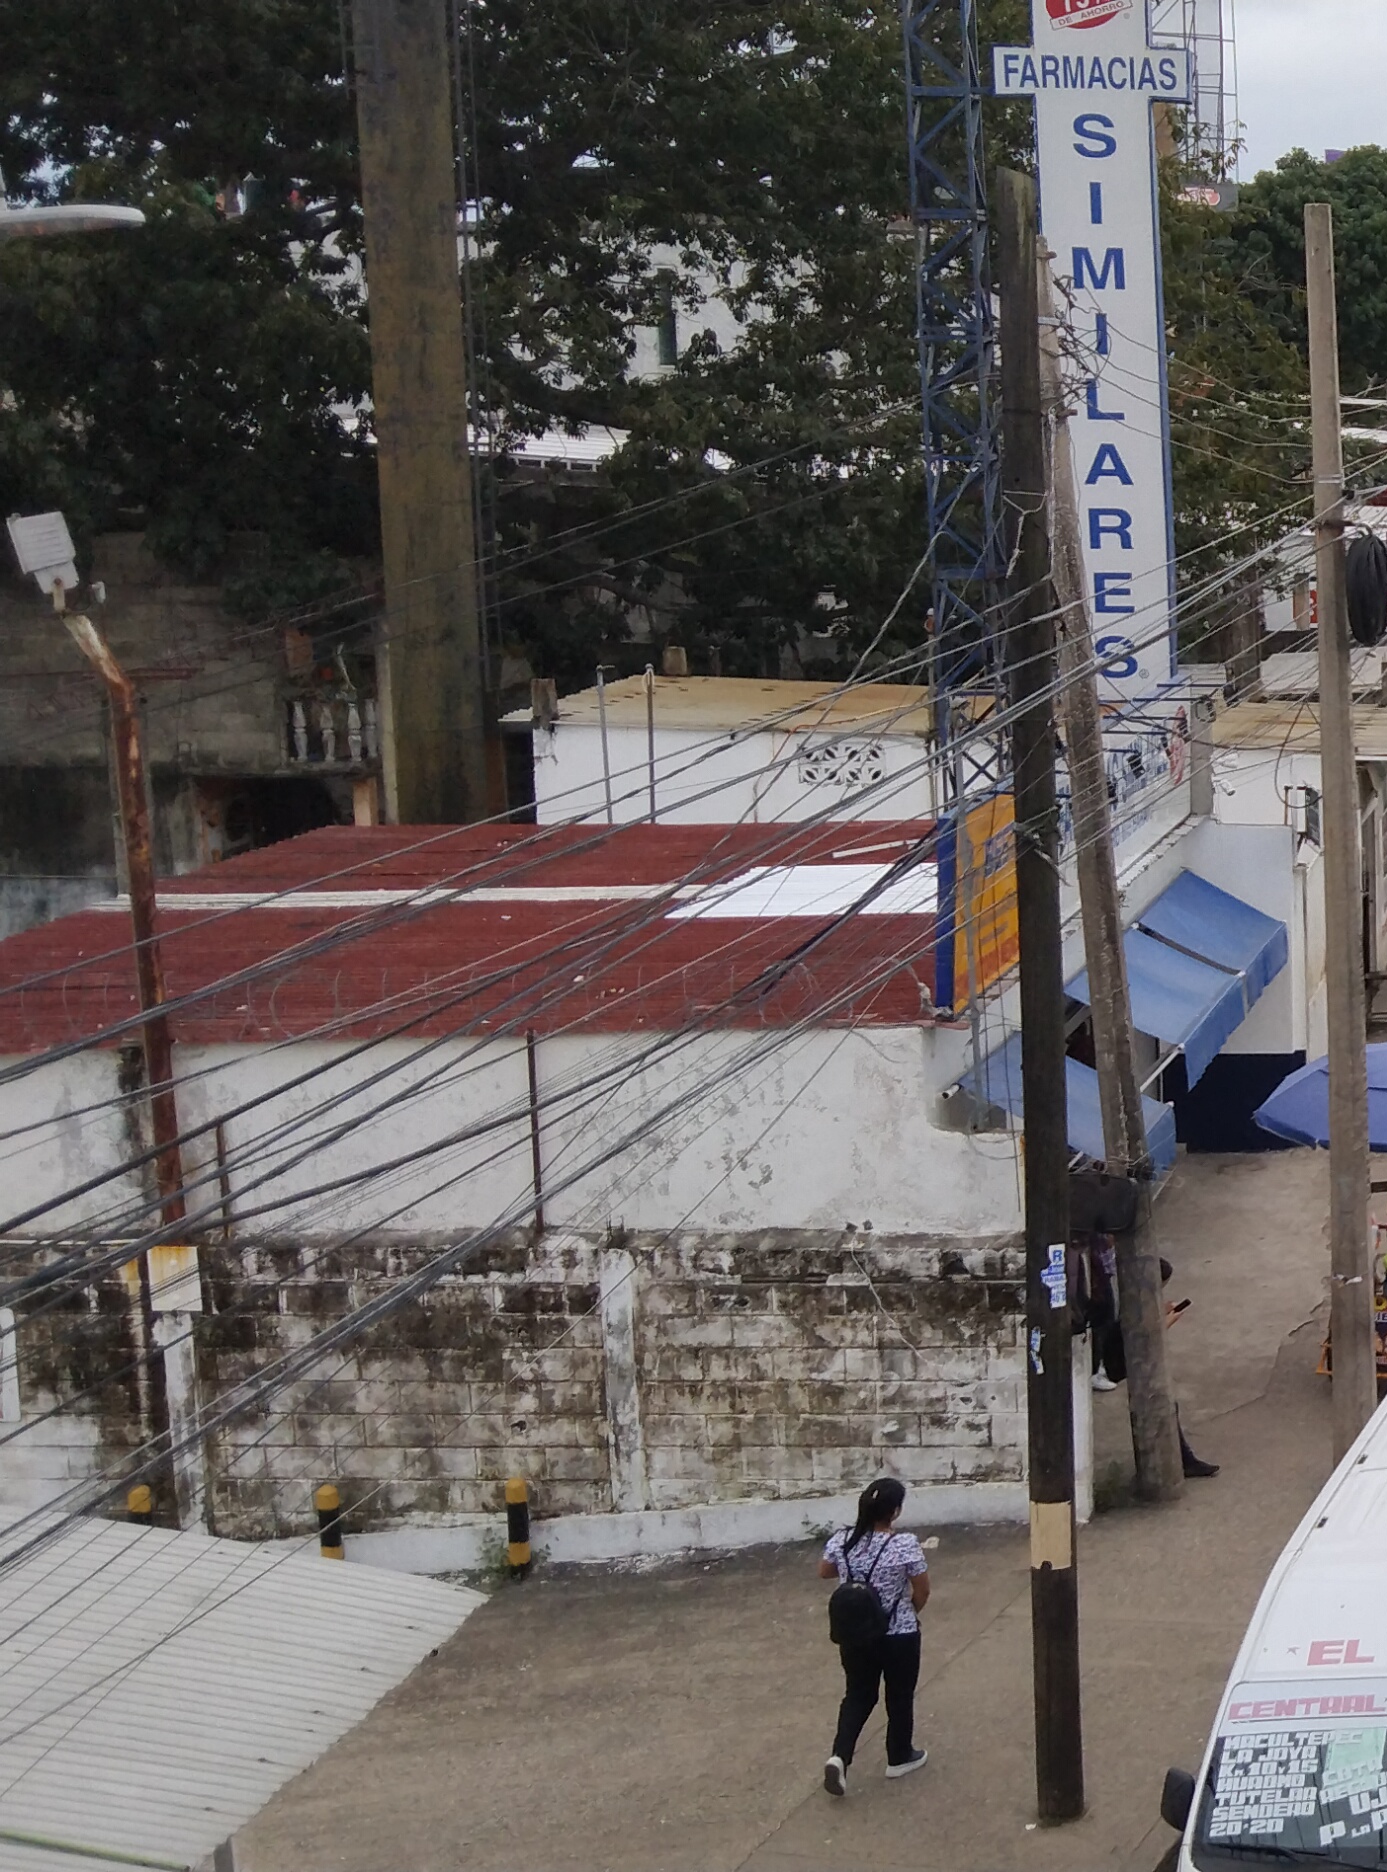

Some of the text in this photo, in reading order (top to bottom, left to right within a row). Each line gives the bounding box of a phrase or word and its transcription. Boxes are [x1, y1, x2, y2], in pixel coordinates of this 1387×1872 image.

[1058, 16, 1073, 26] DE
[1080, 2, 1125, 20] AHORRO
[1003, 54, 1177, 90] FARMACIAS
[1072, 113, 1138, 679] SIMILARES
[1307, 1639, 1375, 1666] EL
[1228, 1694, 1386, 1720] CENTRAL
[1223, 1730, 1364, 1750] MACULTEPEC
[1222, 1745, 1318, 1764] LA JOYA
[1215, 1786, 1318, 1807] TUTELAR
[1211, 1801, 1316, 1823] SENDERO
